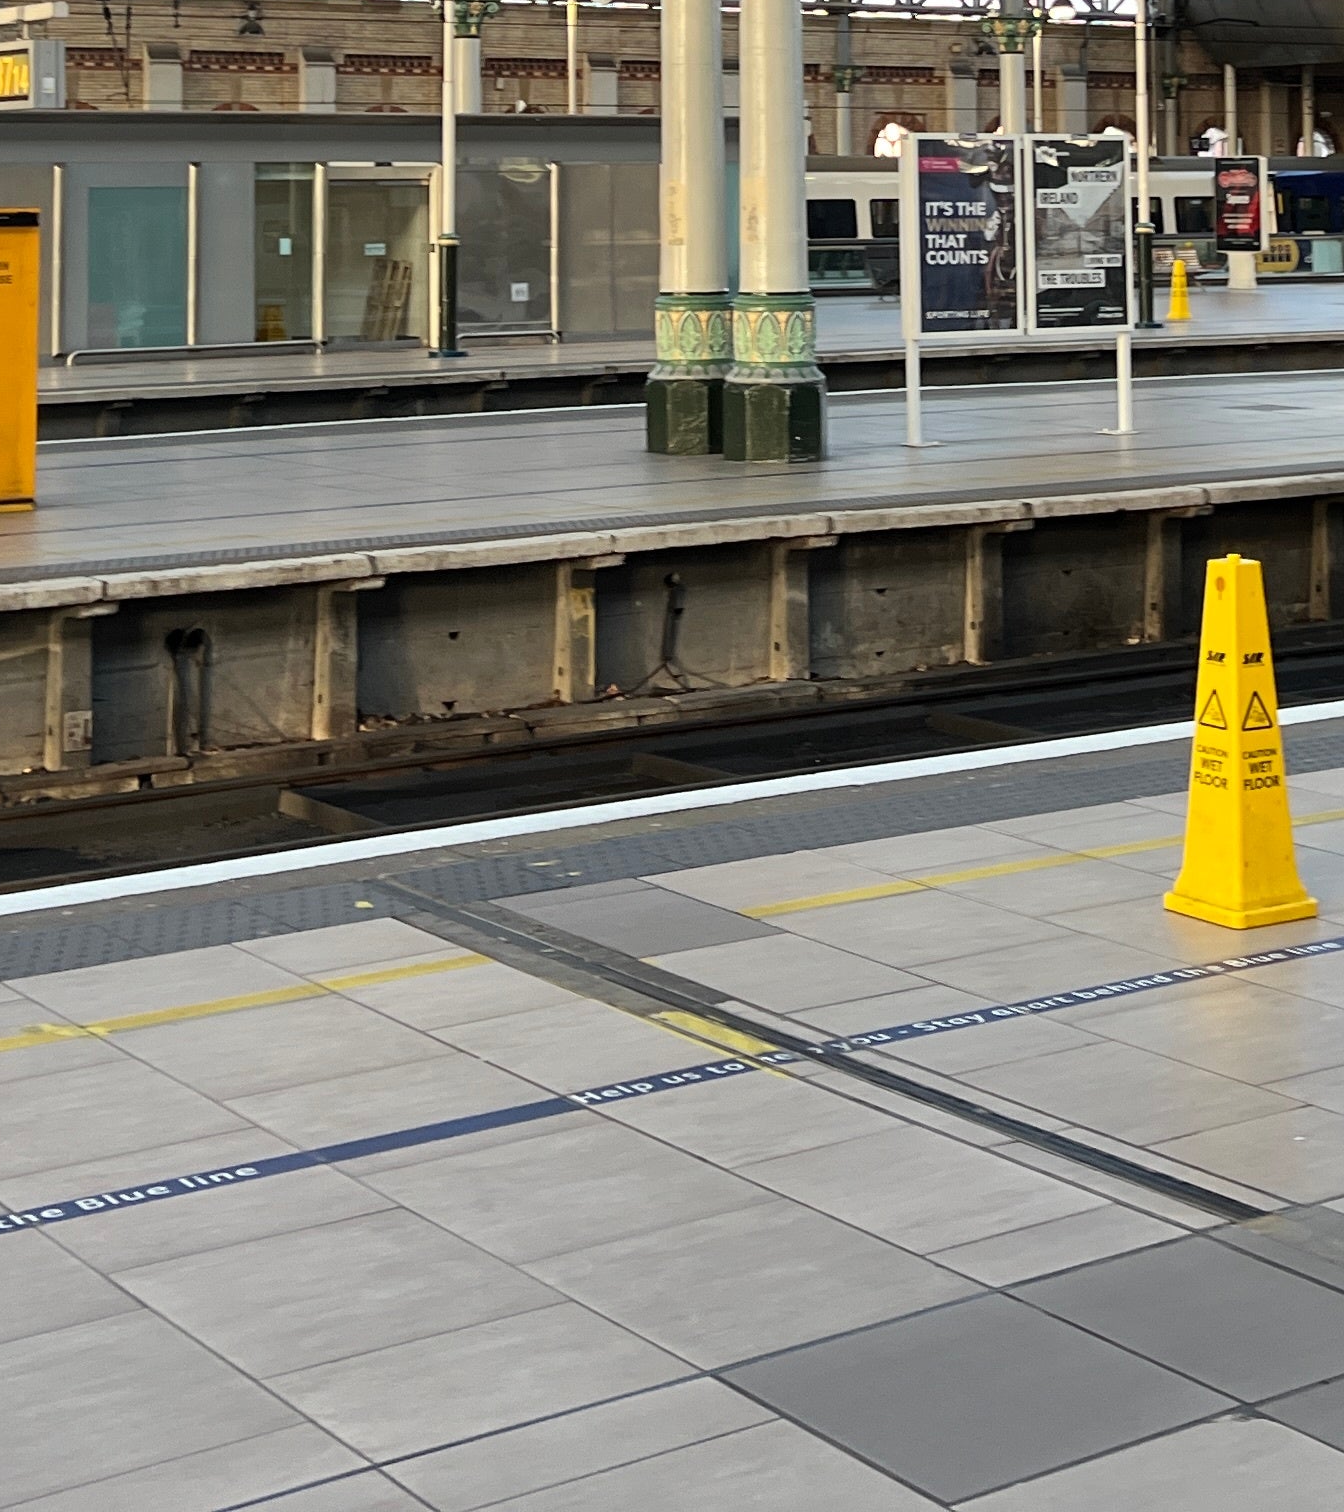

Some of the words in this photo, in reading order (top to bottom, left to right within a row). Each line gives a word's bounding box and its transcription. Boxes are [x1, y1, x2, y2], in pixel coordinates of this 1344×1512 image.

[925, 201, 954, 216] IT'S
[956, 202, 987, 216] THE
[925, 234, 967, 248] THAT
[925, 250, 989, 265] COUNTS
[1200, 758, 1223, 772] WET
[1248, 759, 1272, 774] WET
[1194, 771, 1229, 790] FLOOR
[1242, 774, 1280, 791] FLOOR
[571, 1078, 656, 1105] Help
[660, 1069, 702, 1086] us
[705, 1061, 744, 1076] to
[912, 1010, 985, 1033] Stay
[1070, 973, 1174, 1001] behind
[73, 1180, 171, 1212] Blue
[180, 1164, 261, 1190] line
